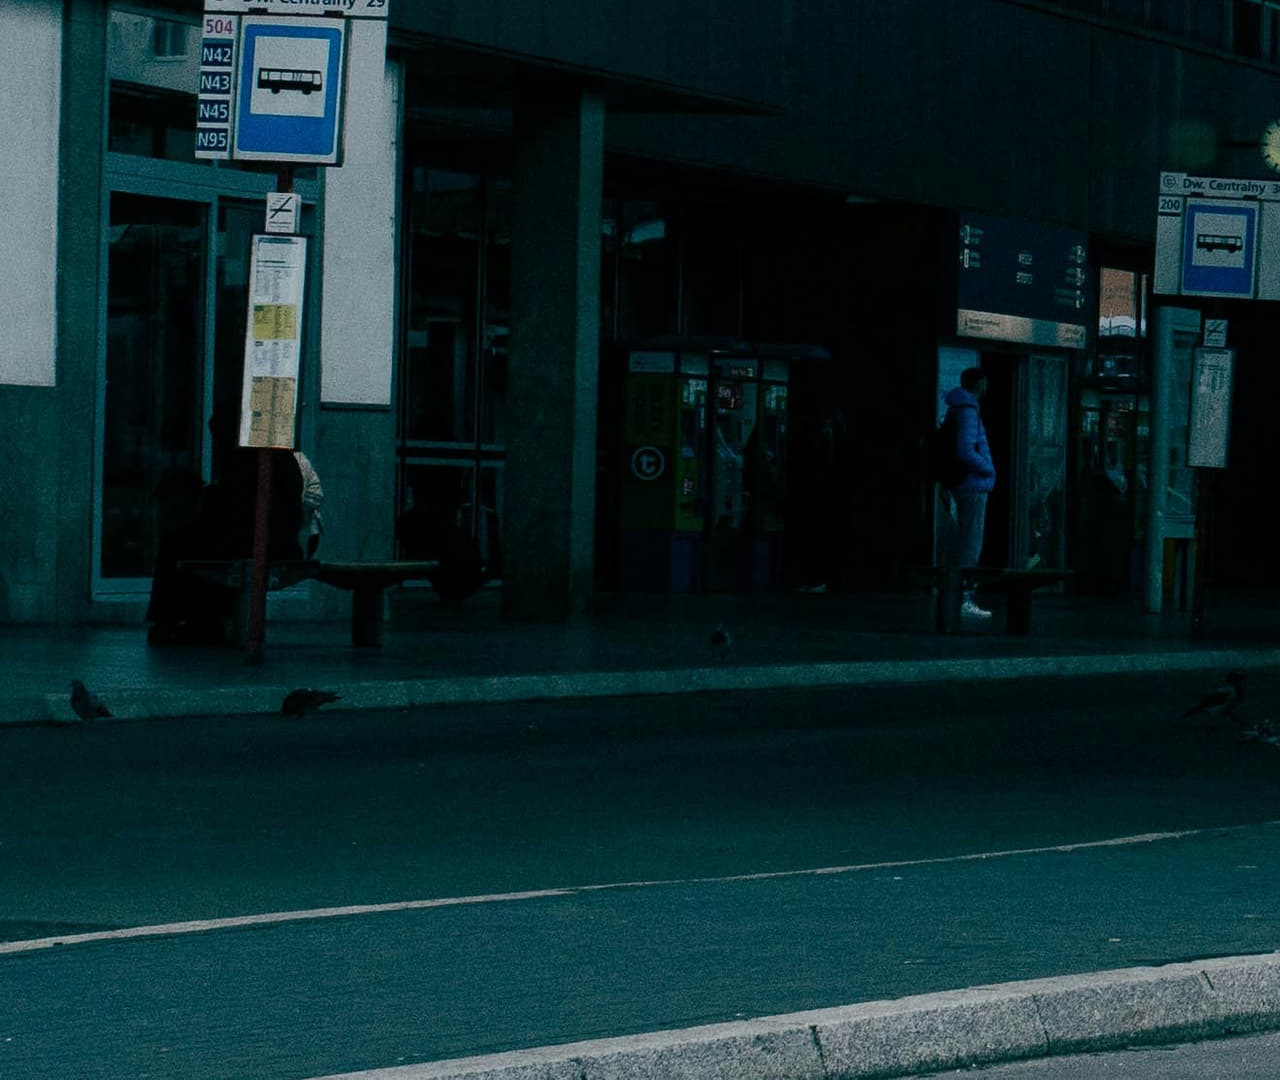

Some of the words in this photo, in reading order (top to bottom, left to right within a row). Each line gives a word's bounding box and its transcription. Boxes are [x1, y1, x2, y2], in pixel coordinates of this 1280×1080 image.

[205, 19, 234, 35] 504
[202, 47, 232, 63] N42
[201, 75, 231, 91] N43
[199, 103, 229, 120] N45
[198, 131, 227, 147] N95
[1183, 179, 1205, 189] Dw.
[1209, 180, 1266, 194] Centralny
[1160, 199, 1180, 210] 200
